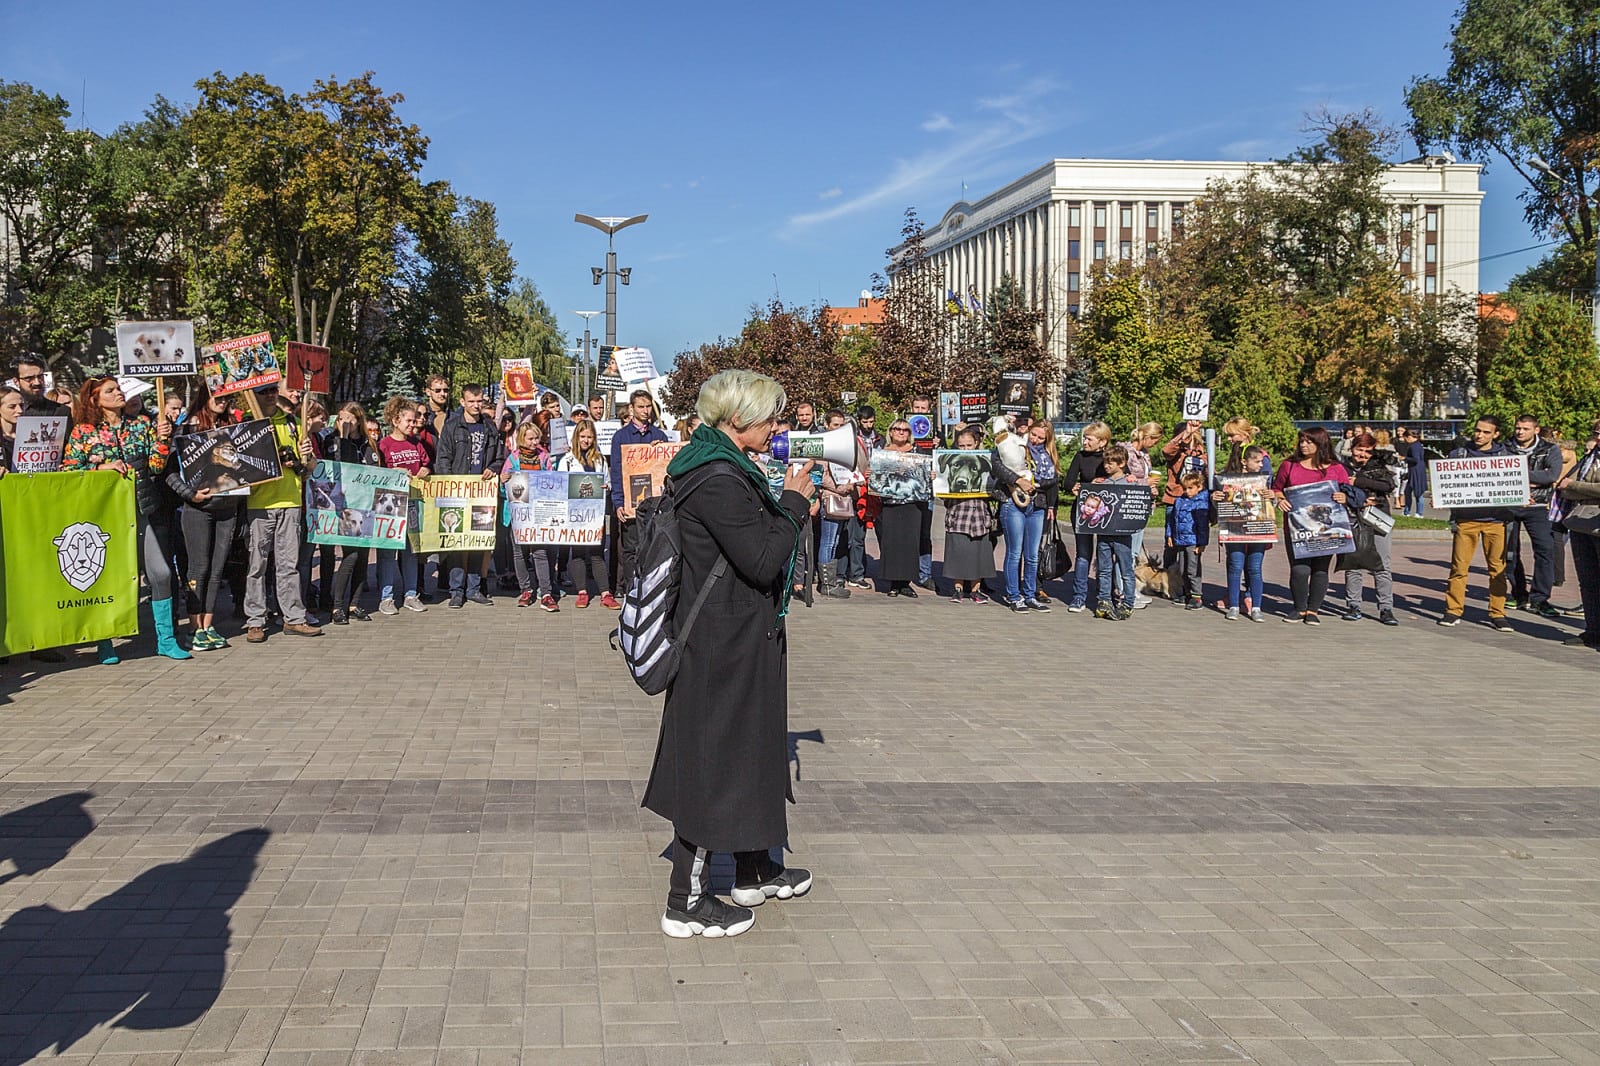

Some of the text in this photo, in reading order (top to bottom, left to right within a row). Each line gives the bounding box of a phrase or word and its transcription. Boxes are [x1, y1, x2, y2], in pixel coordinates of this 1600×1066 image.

[216, 339, 251, 351] ПОМОГИТЕ
[138, 365, 160, 373] ХОЧУ
[162, 364, 189, 372] ЖИТЬ!
[961, 397, 987, 405] КОГО
[234, 430, 252, 445] ОНИ
[181, 438, 218, 468] ПЛАТИШЬ
[183, 442, 197, 455] ТЫ
[17, 450, 59, 463] КОГО
[1435, 458, 1521, 472] BREAKING NEWS
[534, 475, 563, 490] ТВОЯ
[1488, 489, 1524, 497] ВБИВСТВО
[569, 507, 597, 523] БЫЛА
[57, 595, 114, 610] UANIMALS
